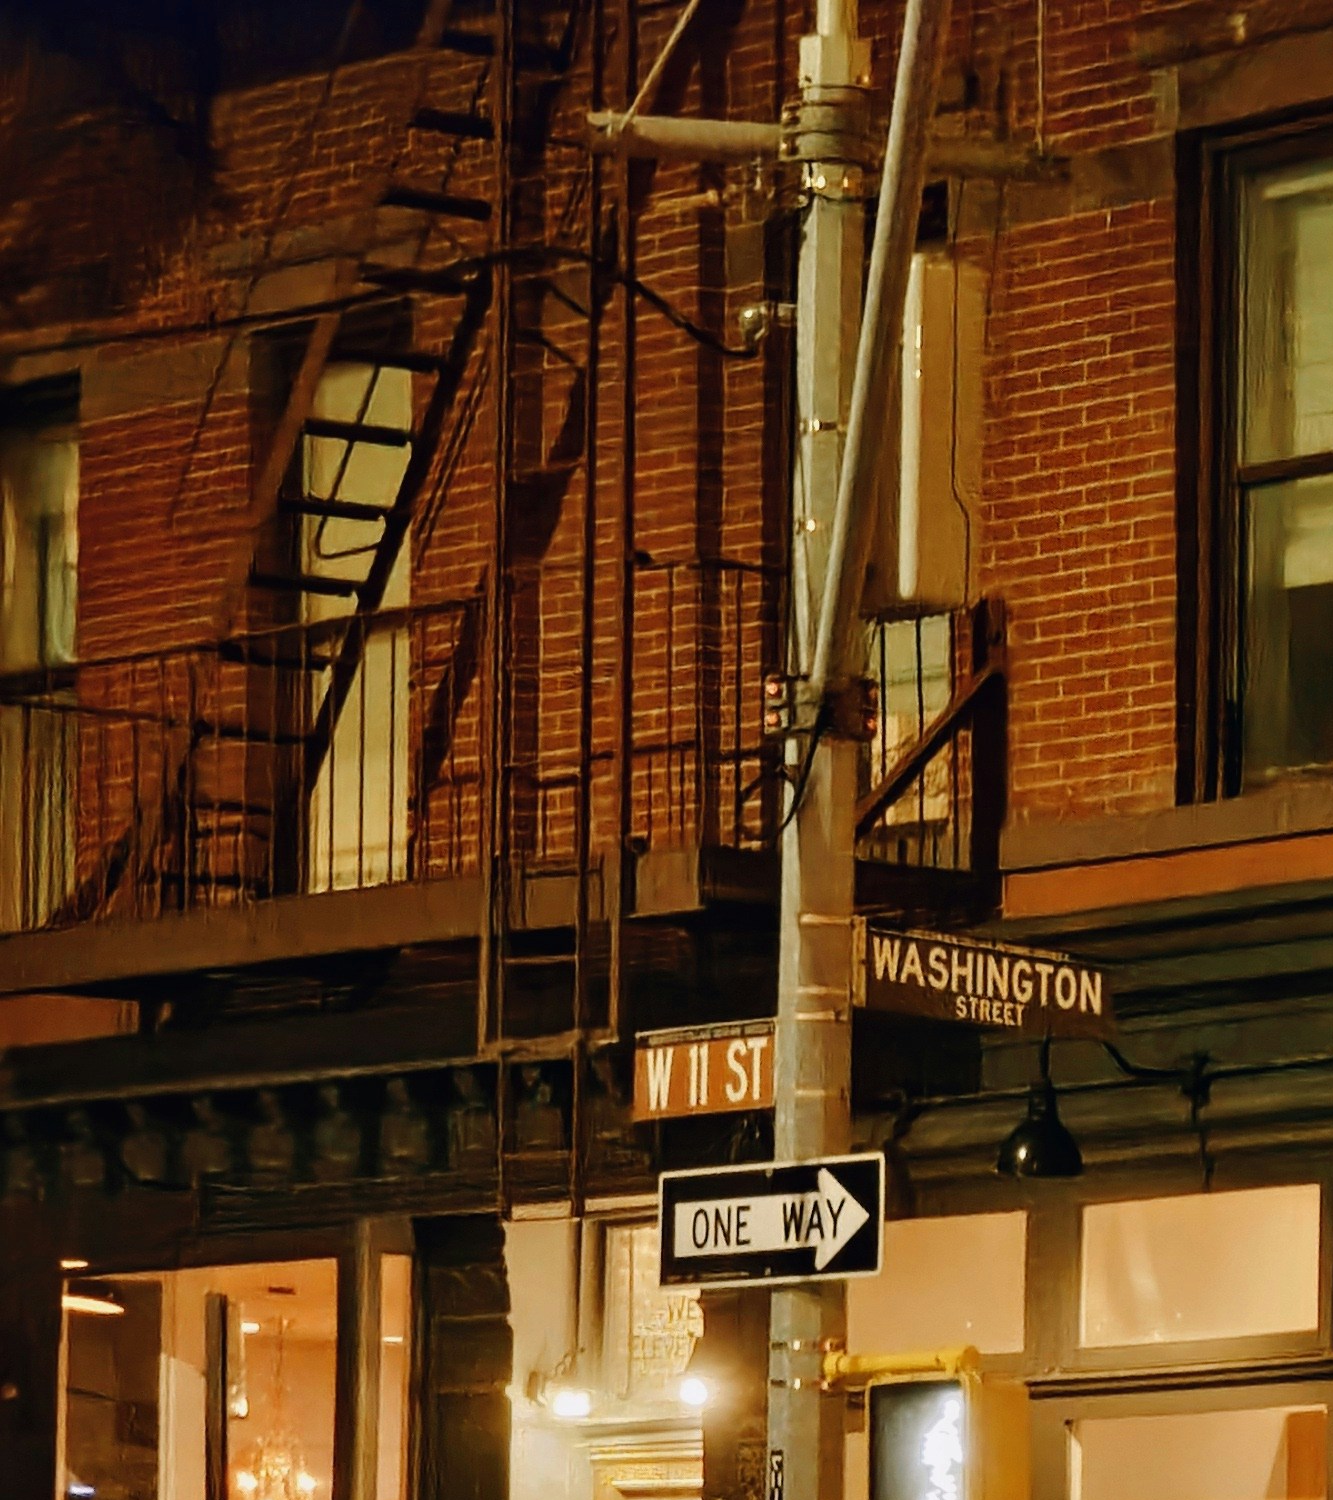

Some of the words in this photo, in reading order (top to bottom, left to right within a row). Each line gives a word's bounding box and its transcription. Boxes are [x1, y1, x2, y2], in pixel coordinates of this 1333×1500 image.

[873, 936, 1102, 1015] WASHINGTON
[955, 995, 1026, 1027] STREET
[647, 1047, 674, 1111] W
[689, 1042, 709, 1107] 11
[725, 1036, 768, 1103] ST
[692, 1205, 751, 1249] ONE
[783, 1197, 846, 1243] WAY
